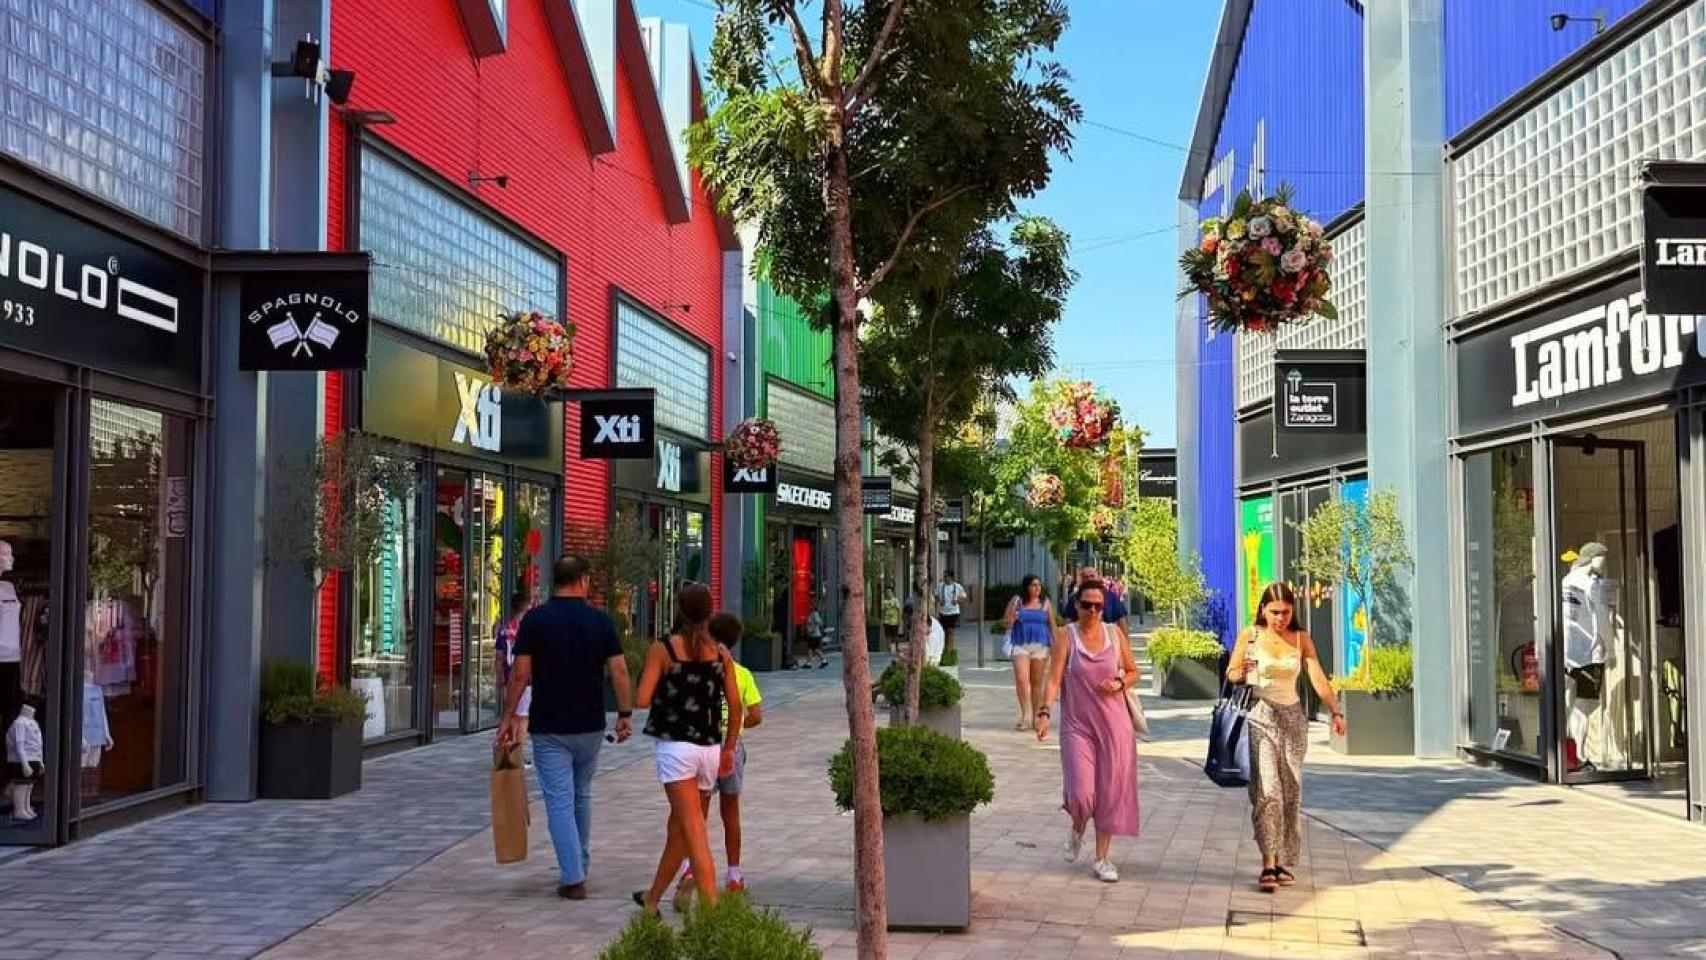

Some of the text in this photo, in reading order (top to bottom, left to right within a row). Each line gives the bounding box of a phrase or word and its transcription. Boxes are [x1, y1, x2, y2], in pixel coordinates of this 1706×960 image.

[247, 293, 359, 324] SPAGNOLO
[452, 371, 502, 452] Xti
[1290, 404, 1323, 412] outlet
[593, 415, 642, 443] Xti
[656, 440, 681, 492] Xti
[776, 482, 832, 510] SKECHERS
